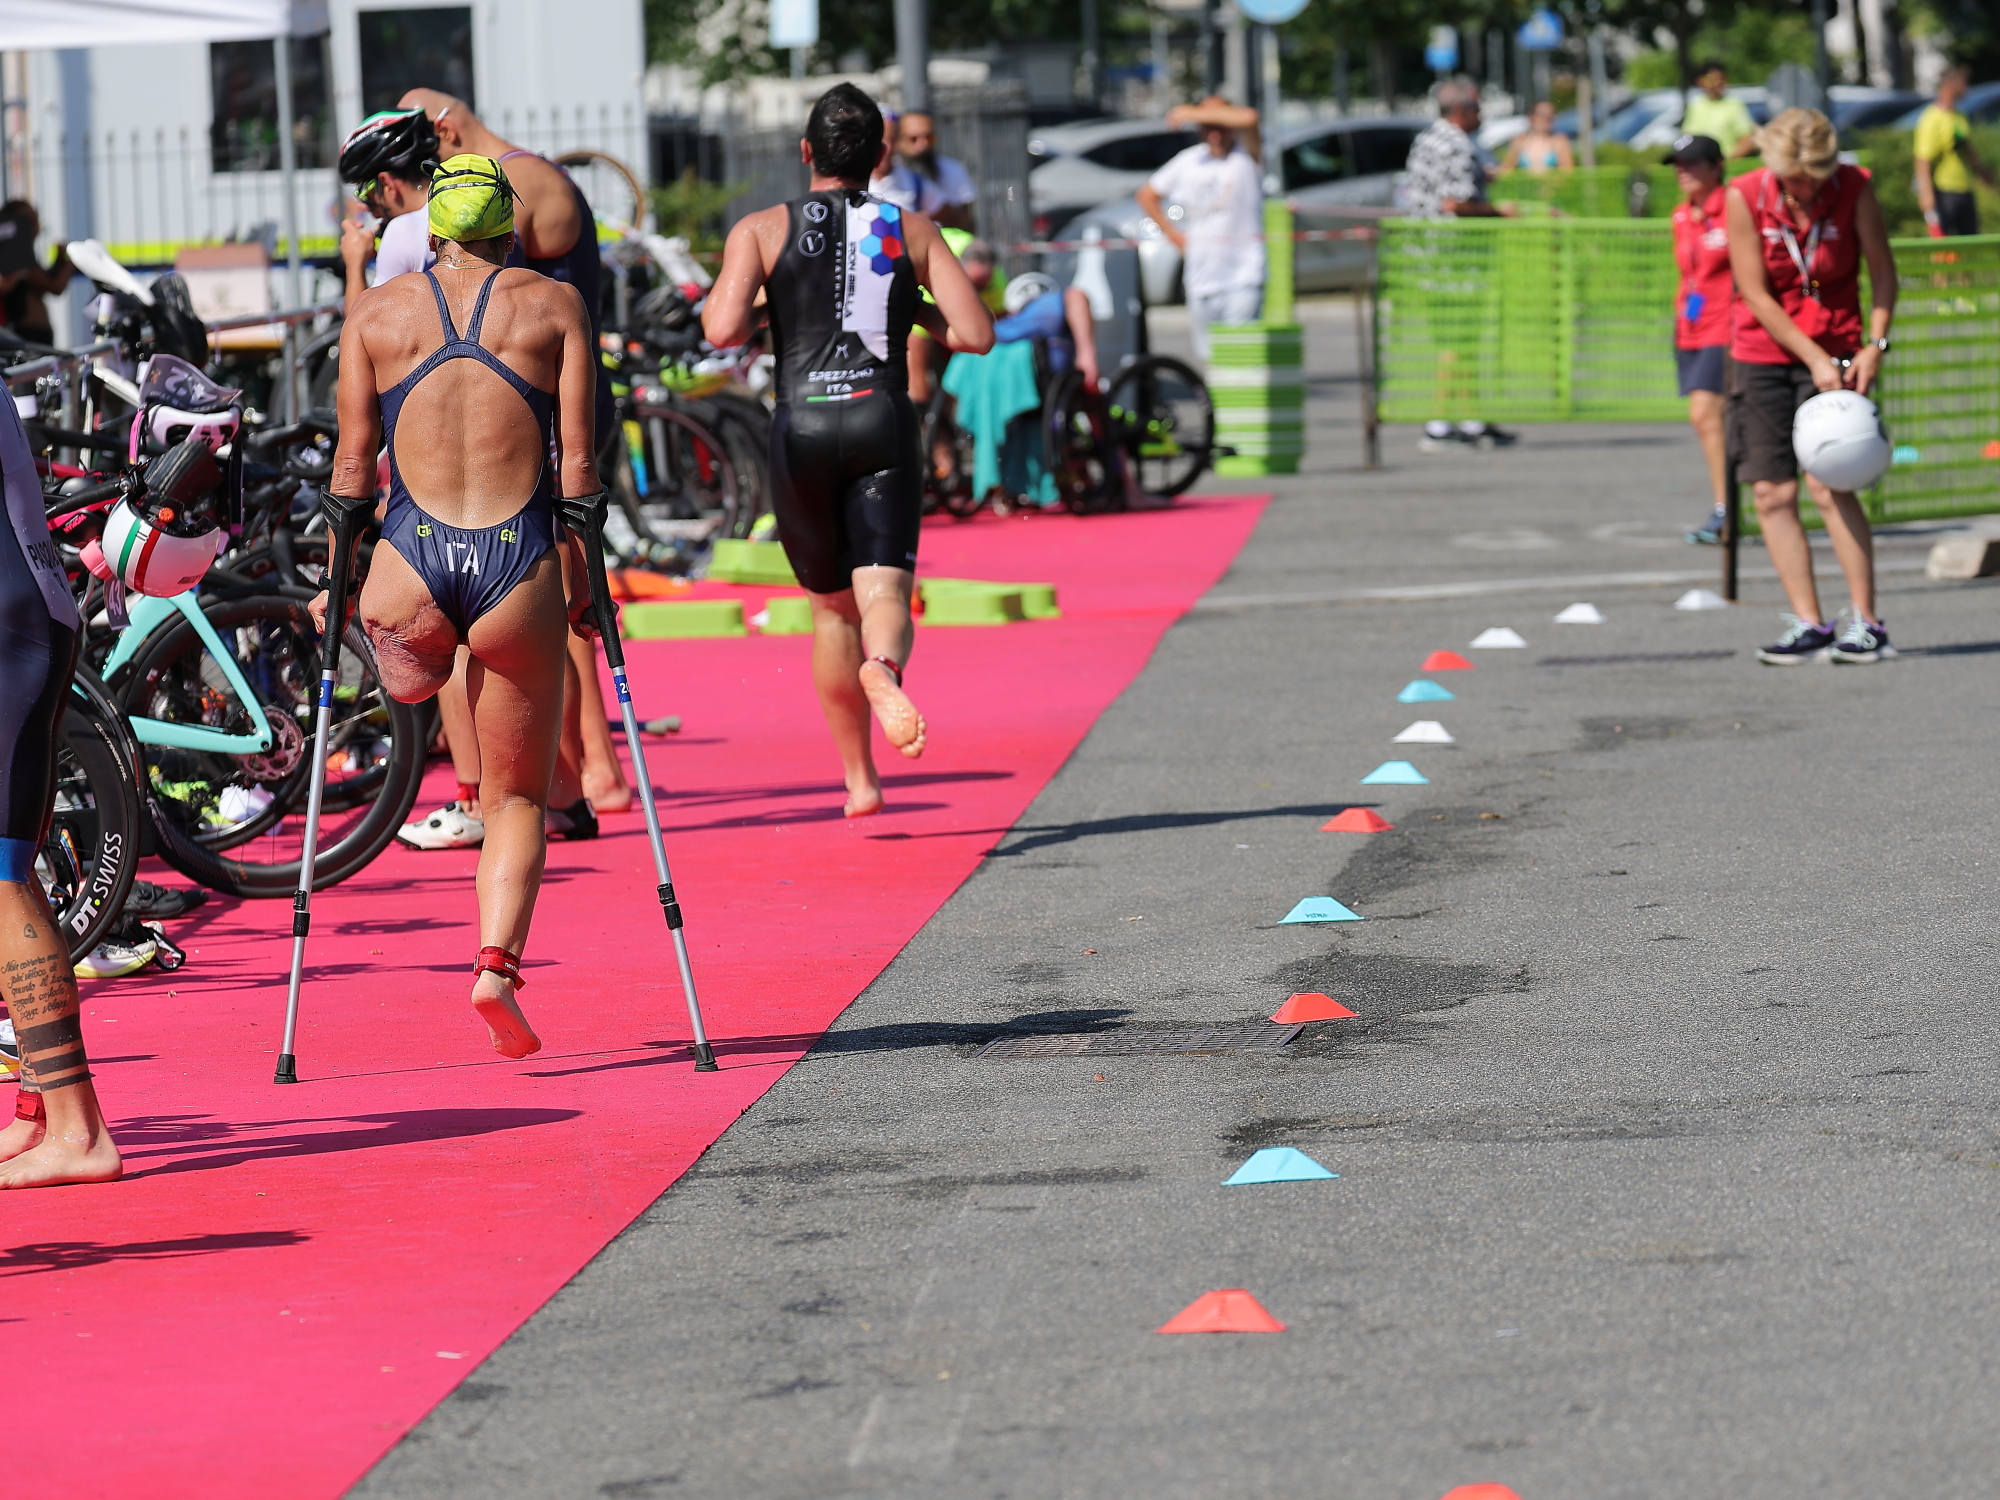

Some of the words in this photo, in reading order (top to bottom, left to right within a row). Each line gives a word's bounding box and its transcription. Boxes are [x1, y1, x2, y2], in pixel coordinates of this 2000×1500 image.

[826, 383, 853, 394] ITA
[445, 541, 480, 576] ITA
[70, 896, 98, 936] DT
[93, 831, 123, 899] SWISS
